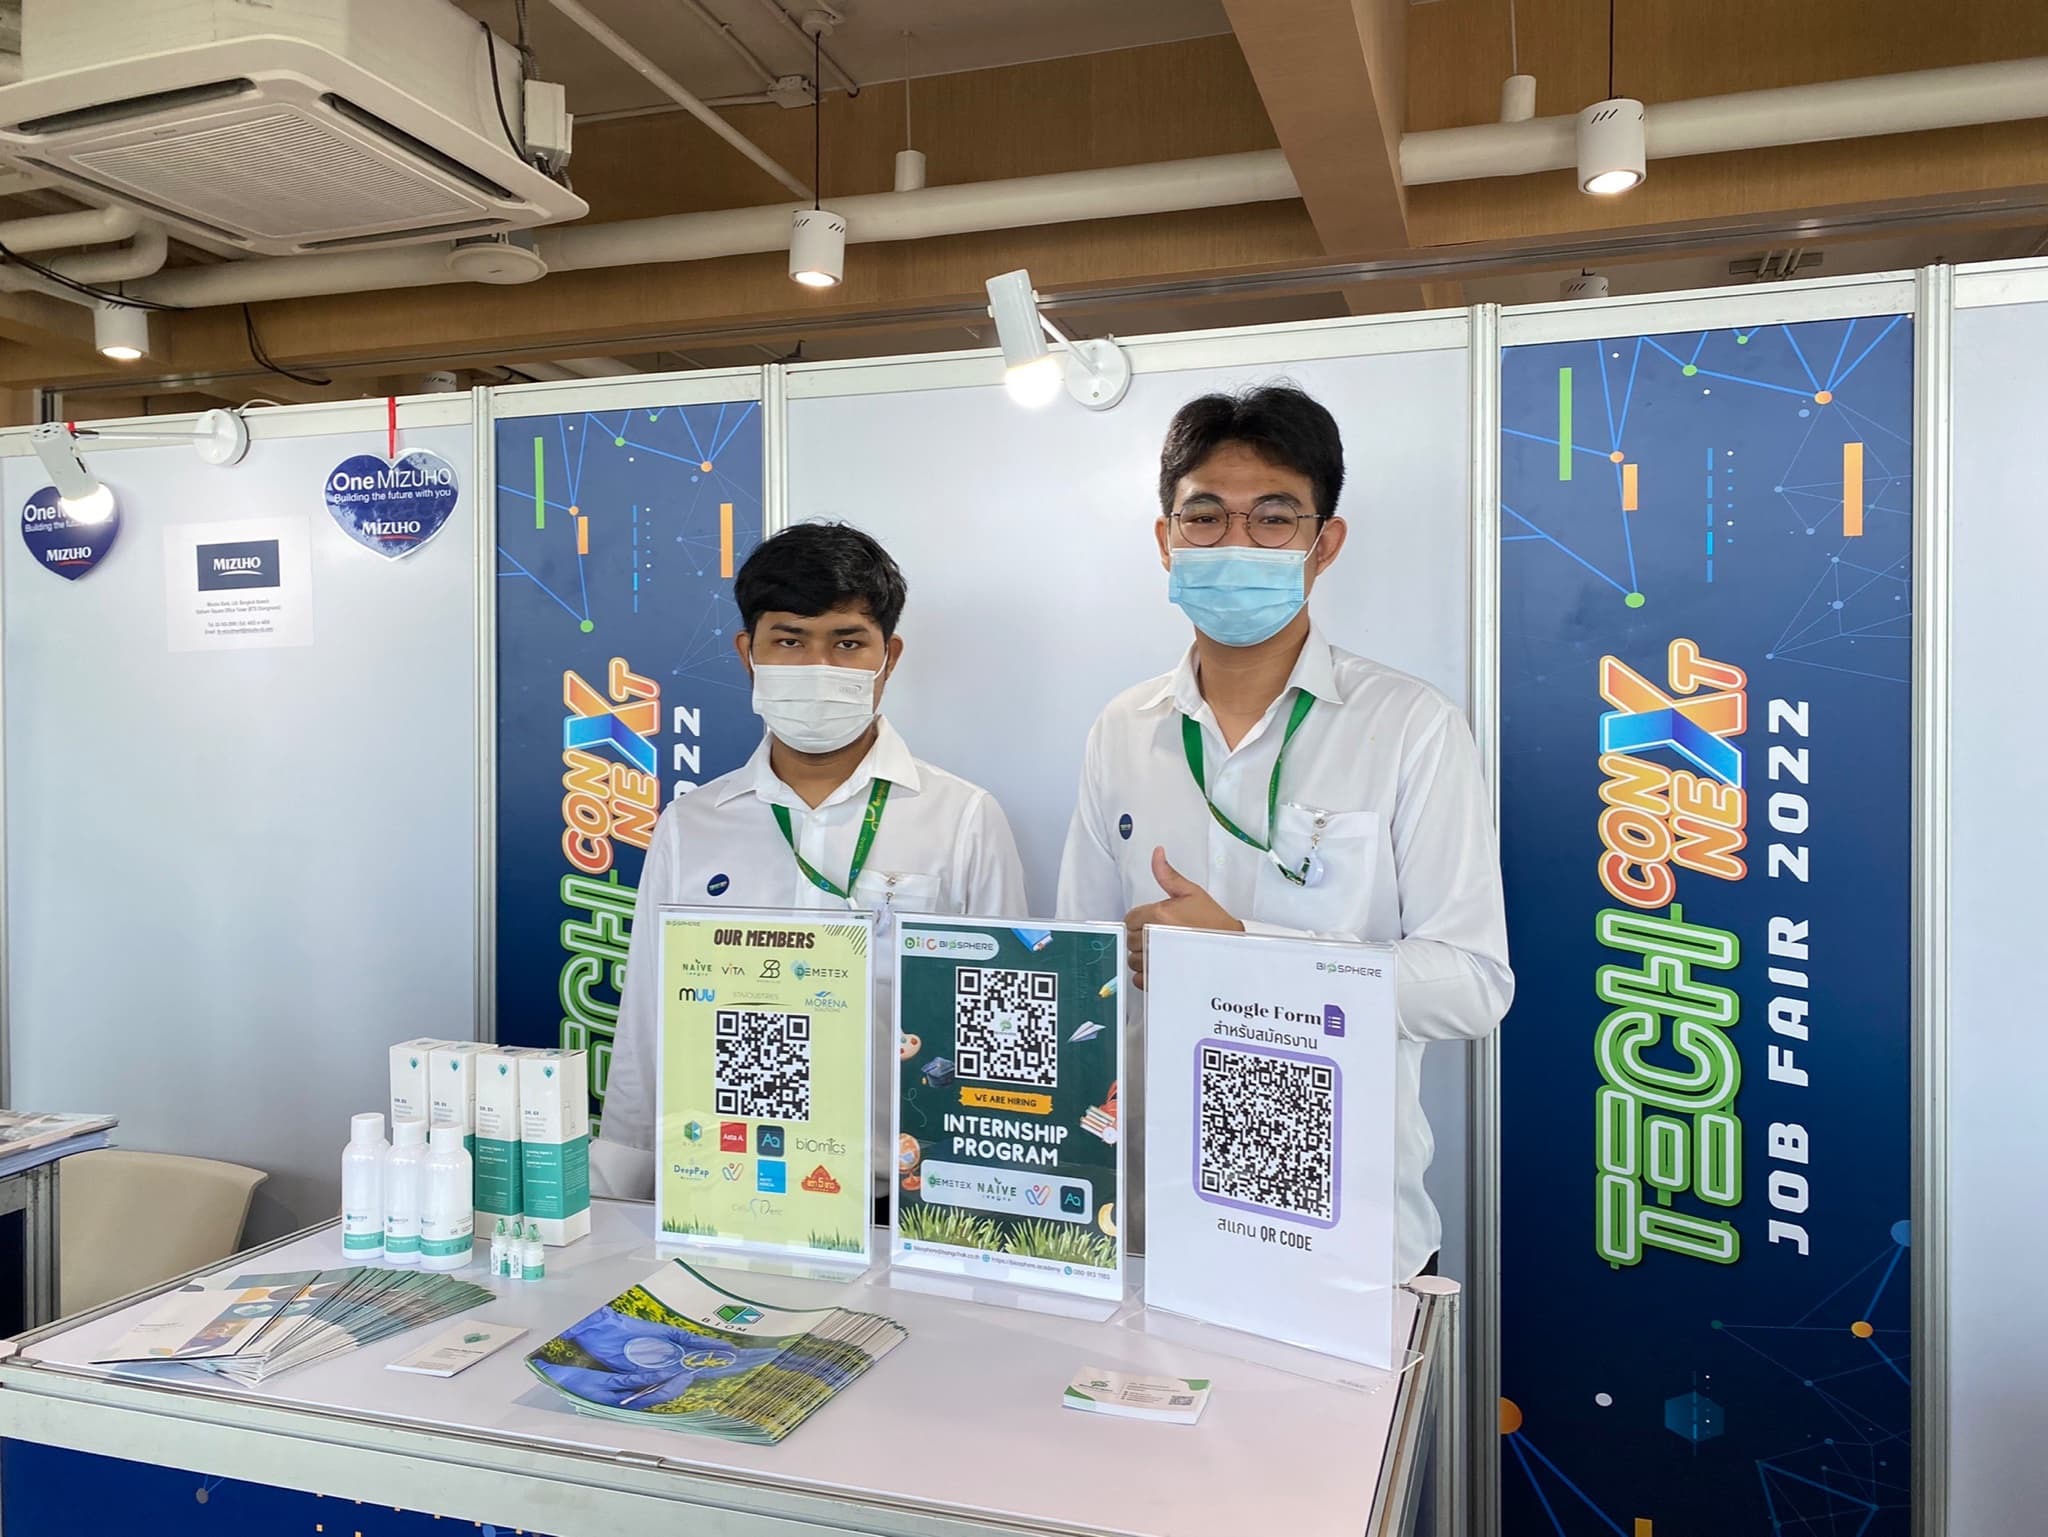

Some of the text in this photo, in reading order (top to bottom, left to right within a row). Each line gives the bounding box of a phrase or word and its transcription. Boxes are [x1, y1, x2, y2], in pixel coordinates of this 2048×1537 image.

[332, 467, 451, 491] One MIZUHO
[334, 488, 451, 504] Building the future with you
[23, 504, 56, 522] One
[25, 523, 52, 533] Building
[361, 520, 421, 535] MIZUHO
[45, 546, 92, 562] MIZUHO
[213, 556, 261, 571] MIZUHO
[713, 928, 815, 949] OUR MEMBERS
[939, 940, 994, 951] BIOSPHERE
[1315, 961, 1383, 978] BIOSPHERE
[1768, 698, 1809, 1256] JOB FAIR 2022
[805, 997, 848, 1009] MORENA
[1211, 996, 1322, 1026] Google Form
[1213, 1020, 1318, 1050] สำหรับสมัครงาน
[1594, 907, 1742, 1269] TECH
[974, 1093, 1037, 1107] WE ARE HIRING
[943, 1113, 1068, 1145] INTERNSHIP
[952, 1136, 1058, 1167] PROGRAM
[1217, 1218, 1312, 1252] สแกน QR CODE
